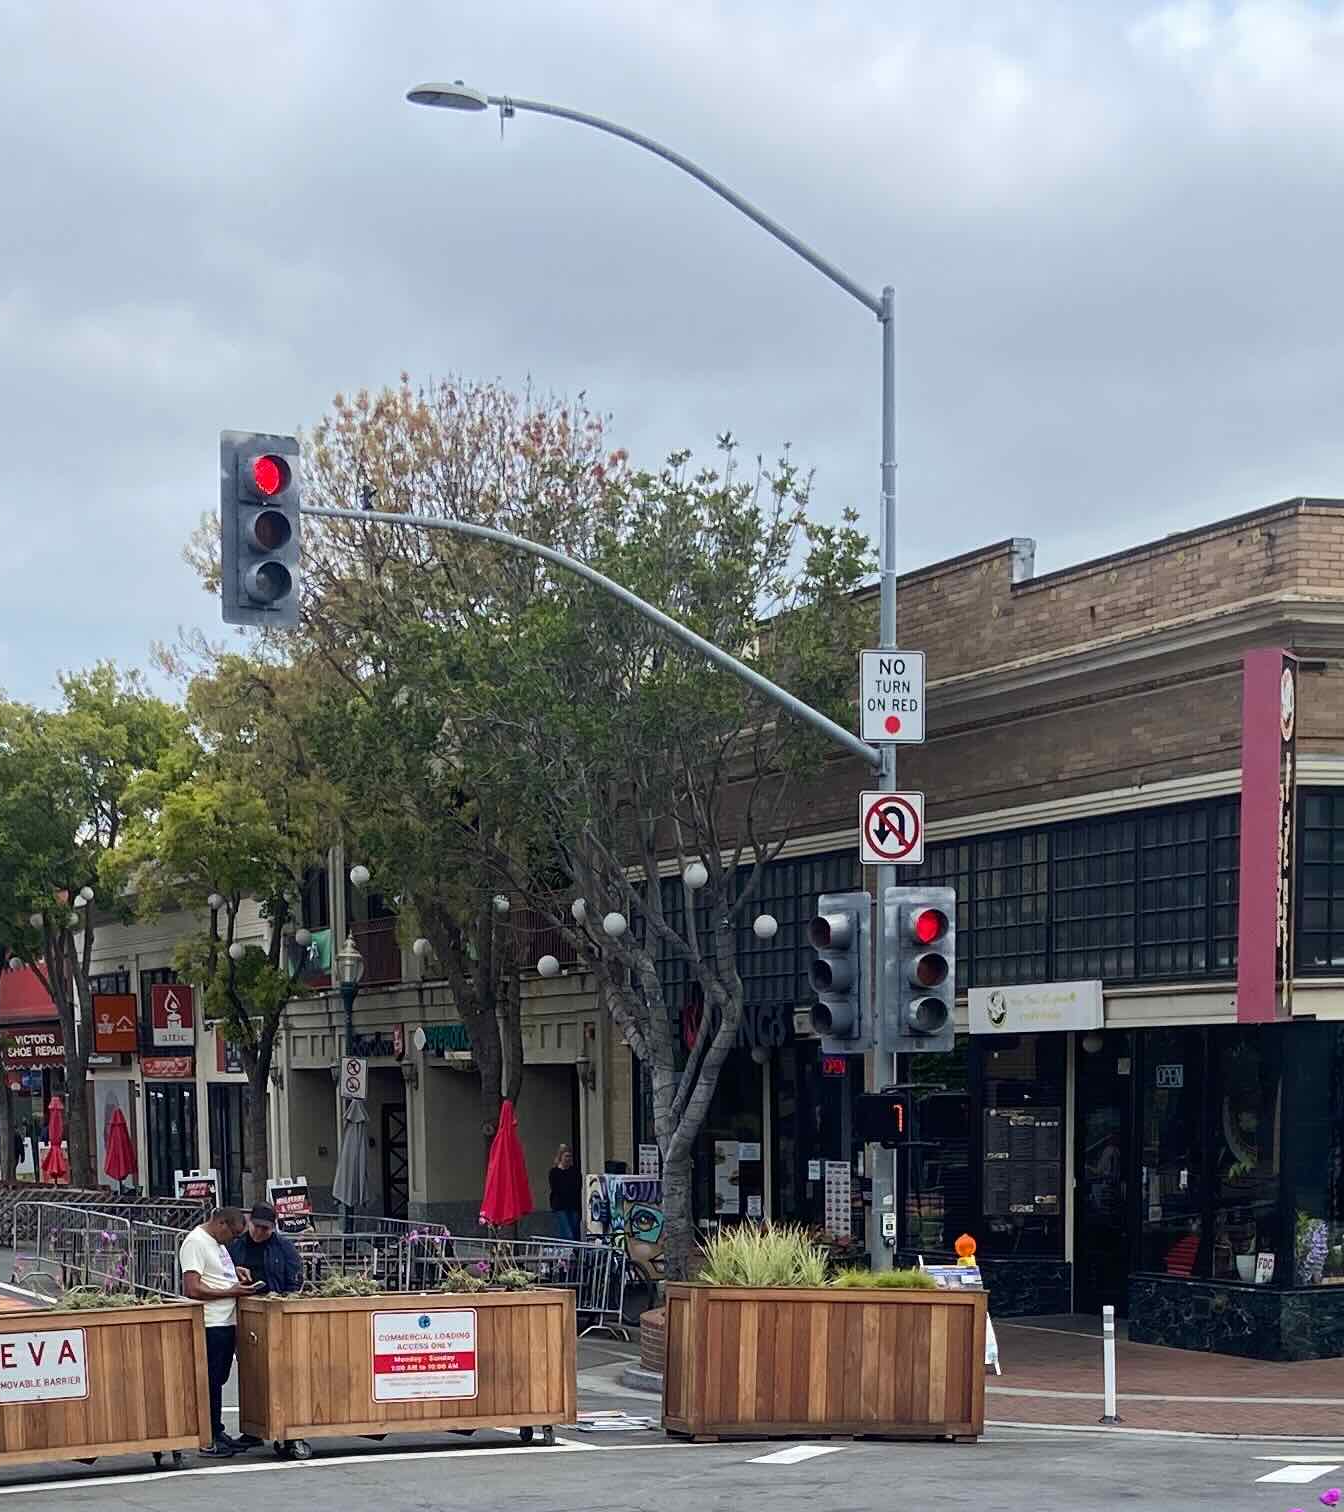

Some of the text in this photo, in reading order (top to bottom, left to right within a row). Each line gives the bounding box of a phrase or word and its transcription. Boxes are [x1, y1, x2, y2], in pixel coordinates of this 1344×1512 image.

[879, 658, 906, 675] NO
[876, 680, 910, 694] TURN
[867, 698, 918, 712] ON RED
[14, 1034, 55, 1045] VICTOR'S
[7, 1045, 65, 1058] SHOE REPAIR
[1158, 1068, 1183, 1085] OPEN
[1258, 1257, 1273, 1270] FDC
[378, 1331, 470, 1342] COMMERCIAL LOADING
[431, 1342, 453, 1350] ONLY
[0, 1340, 77, 1369] EVA
[0, 1375, 81, 1389] MOVABLE BARRIER
